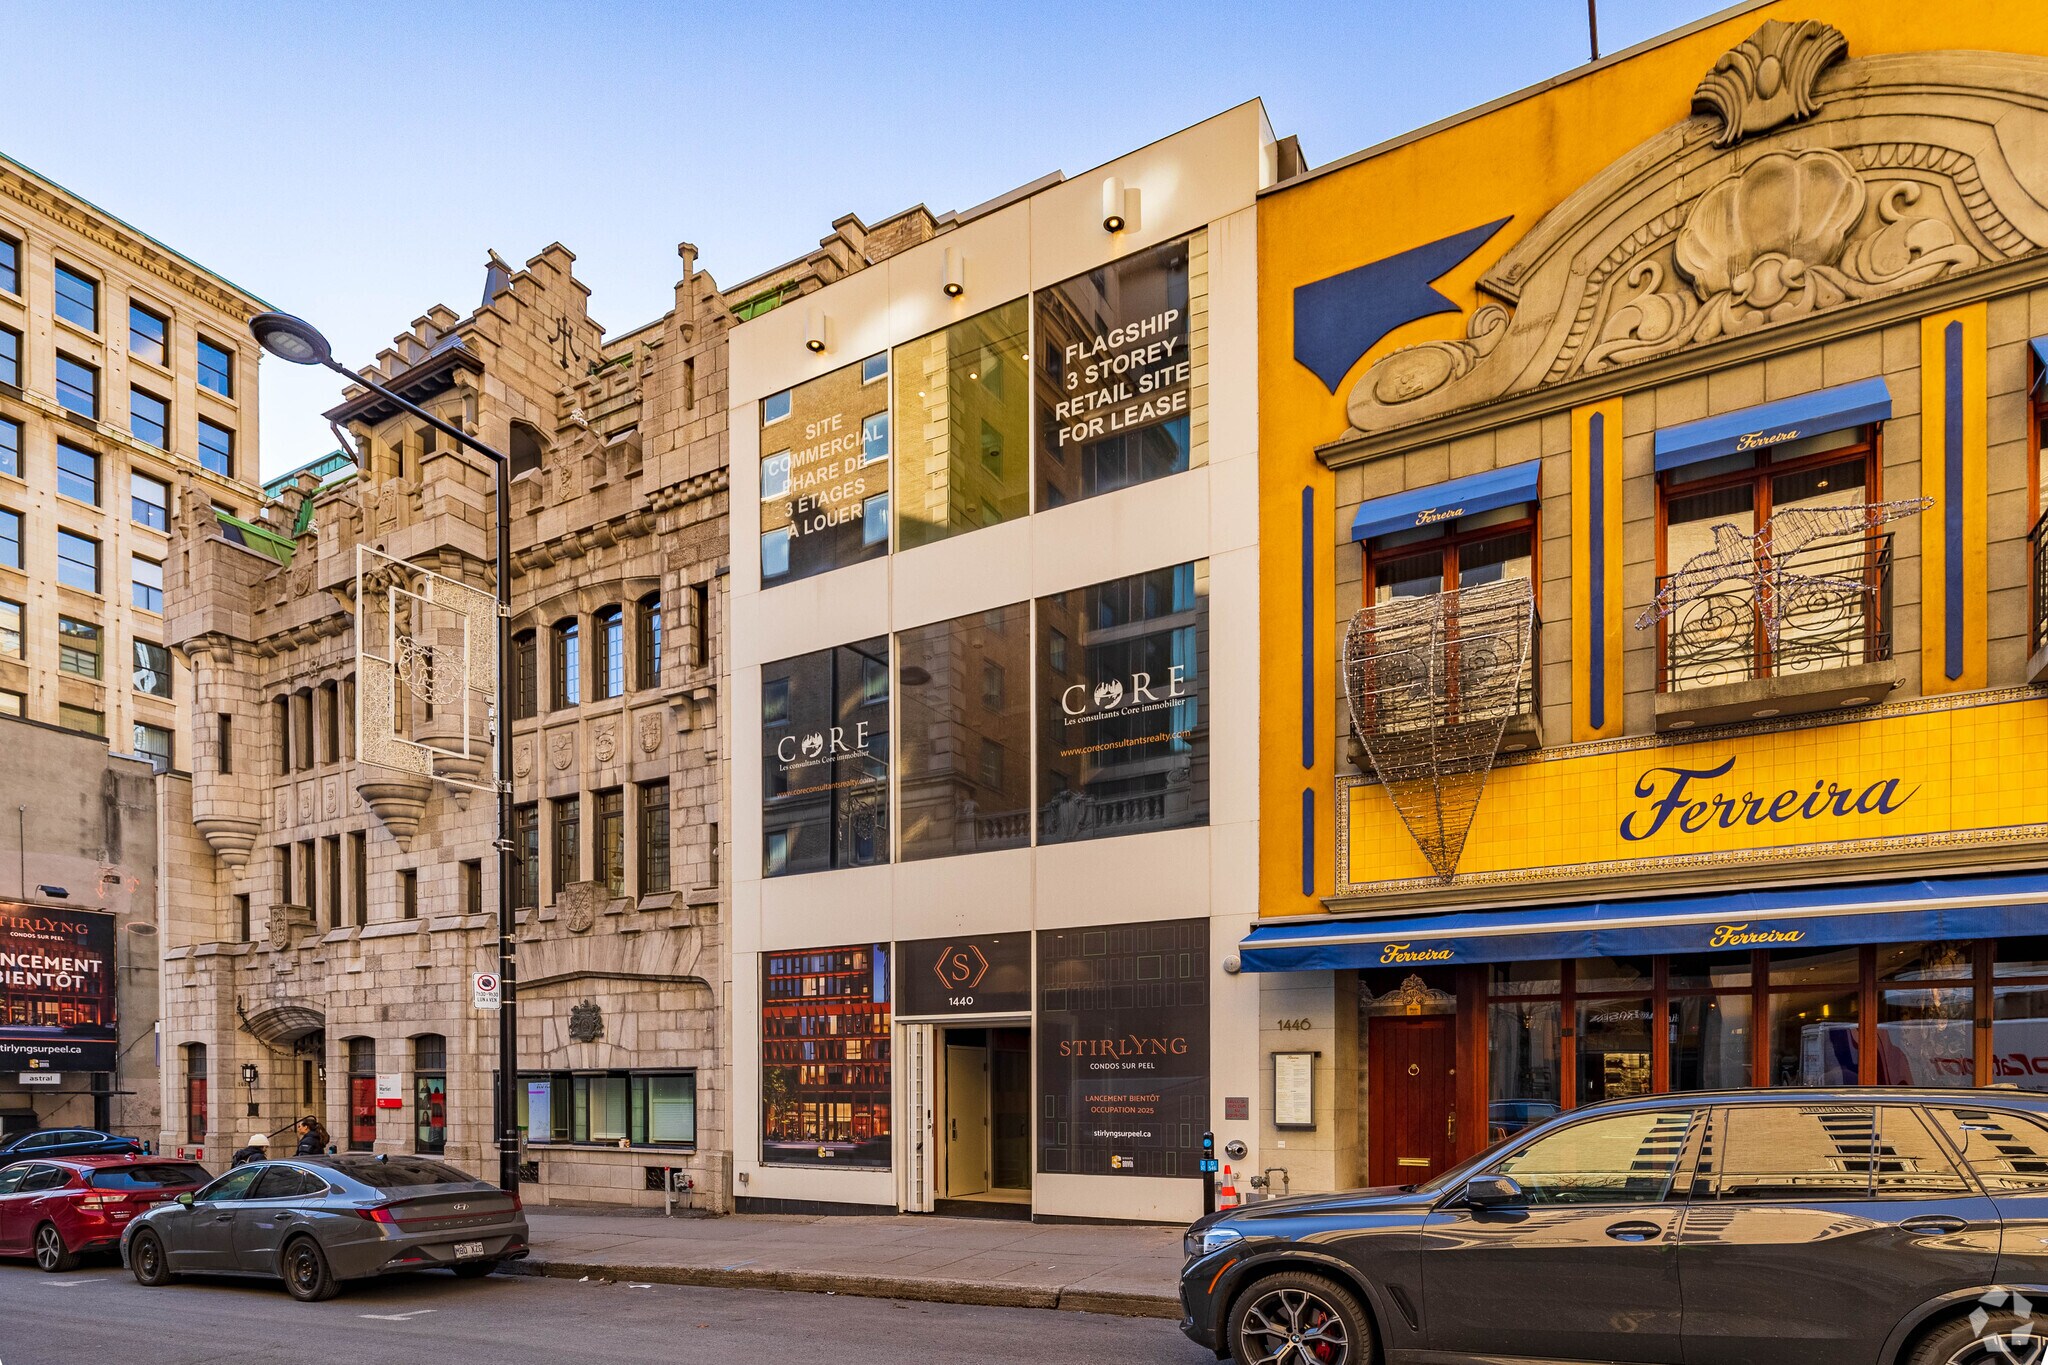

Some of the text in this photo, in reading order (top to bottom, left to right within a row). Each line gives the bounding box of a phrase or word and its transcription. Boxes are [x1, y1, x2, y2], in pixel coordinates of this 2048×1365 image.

[1065, 308, 1179, 365] FLAGSHIP
[1066, 336, 1178, 390] 3 STOREY
[1055, 361, 1190, 422] RETAIL SITE
[805, 413, 843, 441] SITE
[1059, 390, 1187, 447] FOR LEASE
[768, 425, 884, 476] COMMERCIAL
[1736, 429, 1801, 451] Ferreira
[782, 452, 868, 493] PHARE DE
[784, 478, 866, 517] 3 ÉTAGES
[787, 503, 863, 540] À LOUER
[1415, 507, 1465, 526] Ferreira
[1061, 665, 1185, 715] CORE
[1064, 698, 1185, 726] Les consultants Core immobilier
[777, 721, 869, 763] CORE
[1060, 729, 1191, 758] www.coreconsultantsrealty.com
[789, 759, 820, 770] consultants
[821, 756, 835, 764] Core
[836, 750, 869, 761] immobilier
[776, 777, 876, 798] www.coreconsultantsrealty.com
[1620, 755, 1922, 842] Ferreira
[10, 931, 36, 939] CONDOS
[50, 934, 65, 942] PEEL
[1709, 923, 1806, 948] Ferreira
[1379, 943, 1455, 964] Ferreira
[948, 996, 974, 1007] 1440
[1277, 1018, 1312, 1031] 1446
[1059, 1035, 1188, 1060] STIRLYNG
[1090, 1106, 1136, 1114] OCCUPATION
[1129, 1094, 1160, 1102] BIENTÔT
[1093, 1130, 1151, 1138] stirlyngsurpeel.ca
